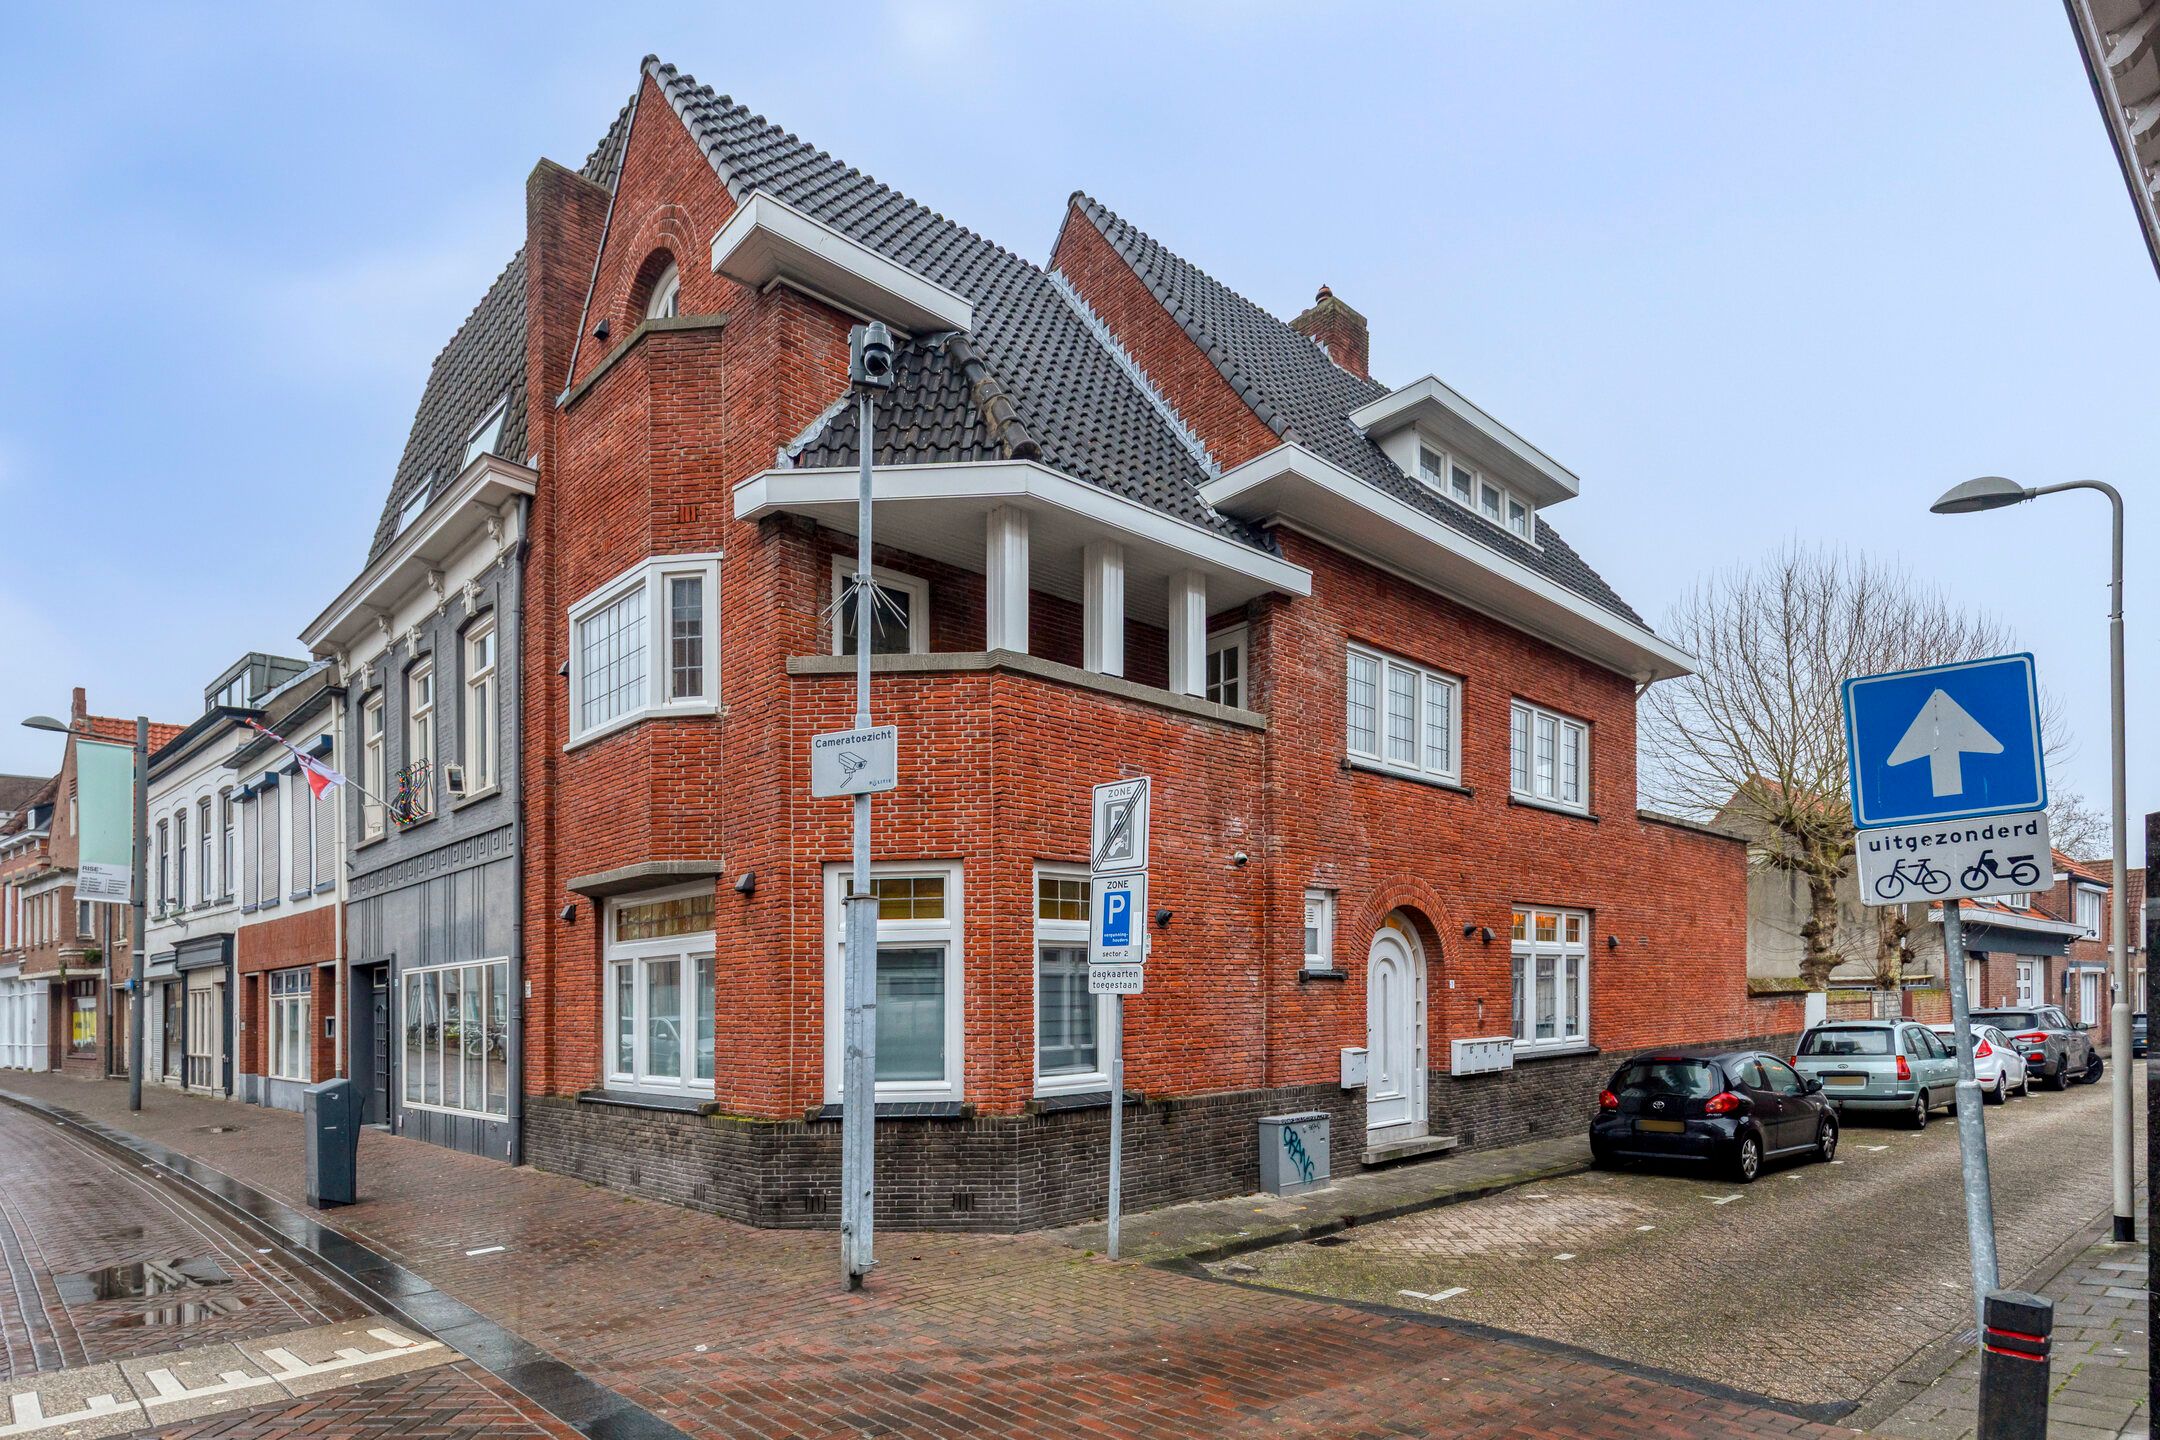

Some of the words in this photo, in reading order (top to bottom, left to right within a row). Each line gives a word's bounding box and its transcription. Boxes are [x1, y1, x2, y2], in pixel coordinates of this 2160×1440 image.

[815, 730, 892, 748] Cameratoezicht
[1108, 786, 1132, 798] ZONE
[1869, 820, 2038, 852] uitgezonderd
[1107, 880, 1129, 889] ZONE
[1108, 894, 1126, 925] P
[1092, 970, 1139, 980] dagkaarten
[1092, 982, 1138, 991] toegestaan
